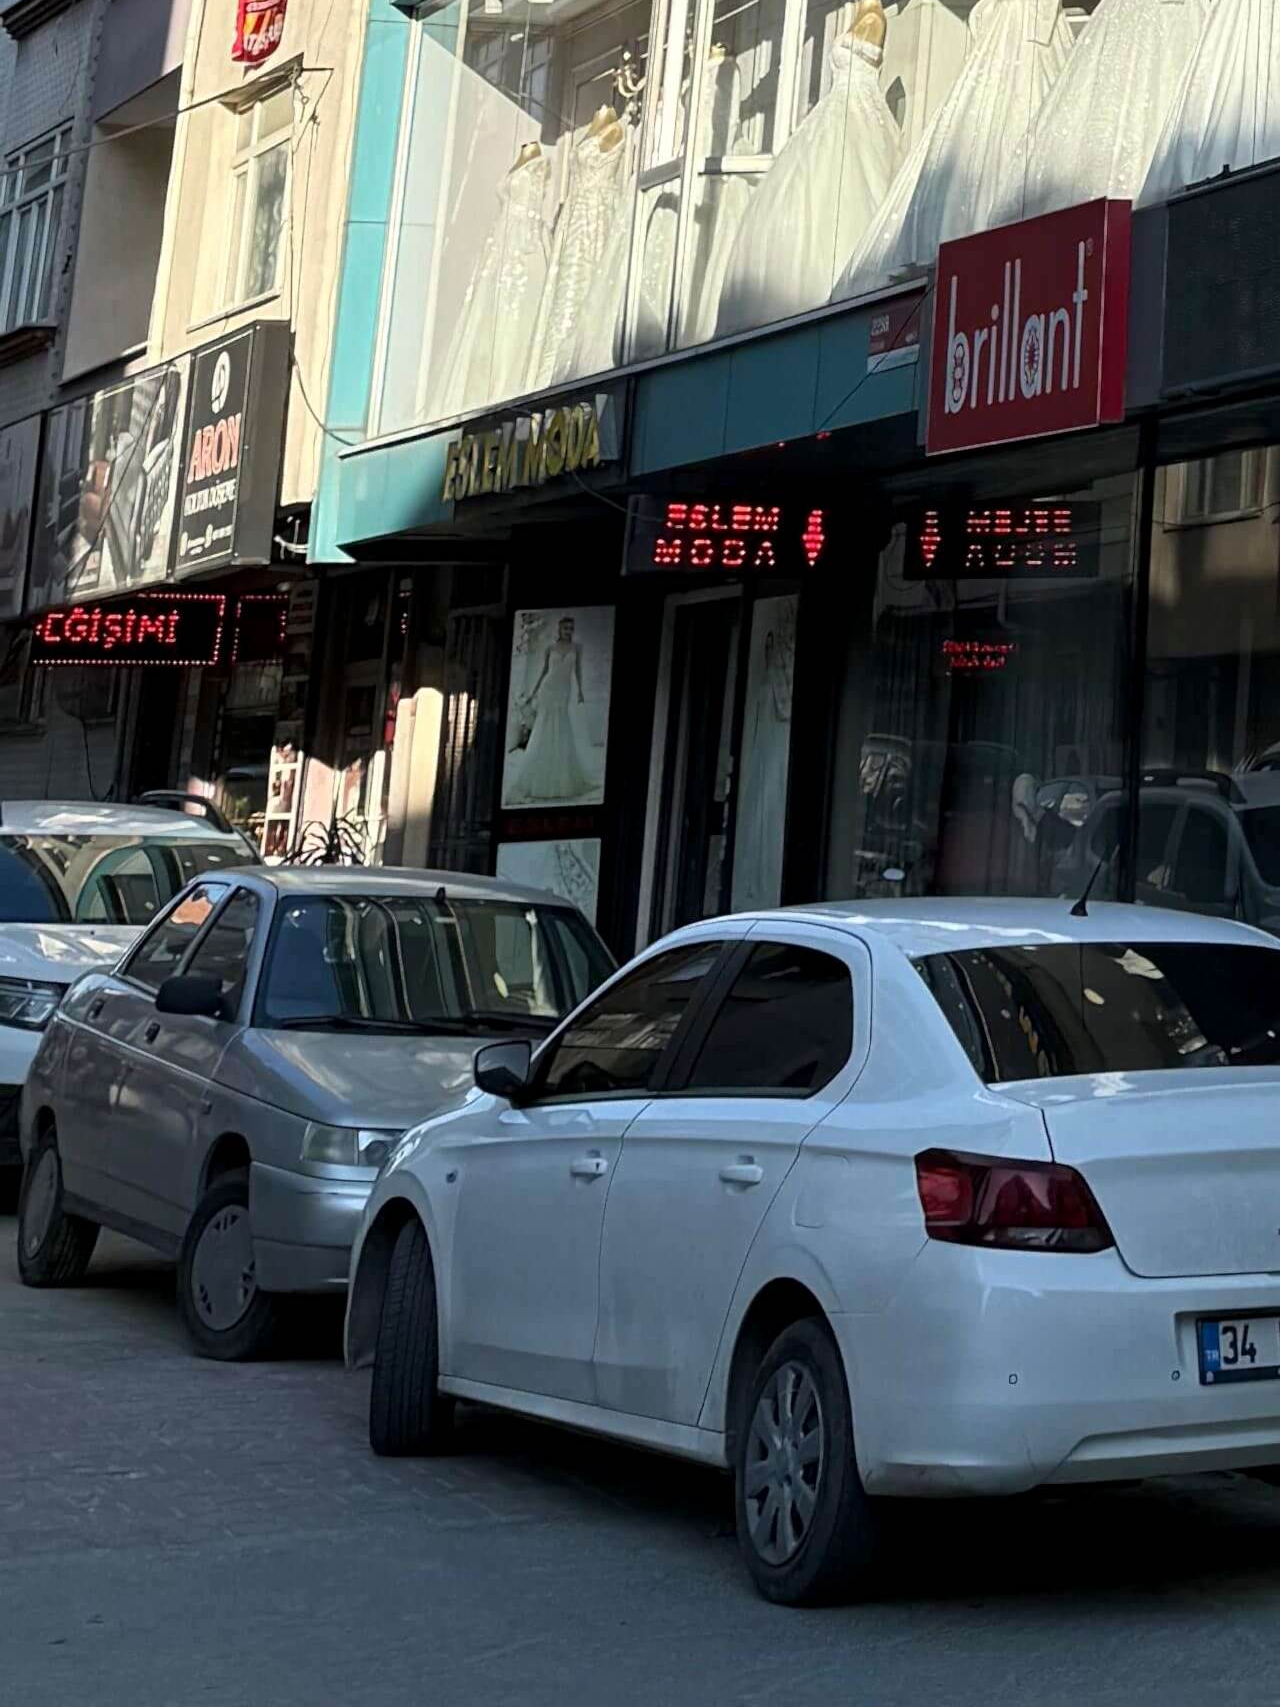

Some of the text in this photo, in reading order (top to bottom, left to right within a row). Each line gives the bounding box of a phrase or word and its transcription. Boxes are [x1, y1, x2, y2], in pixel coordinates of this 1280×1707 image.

[944, 240, 1088, 414] brillant
[187, 413, 242, 484] ARON
[666, 503, 781, 530] ESLEM
[653, 538, 776, 566] MODA
[1222, 1324, 1257, 1365] 34
